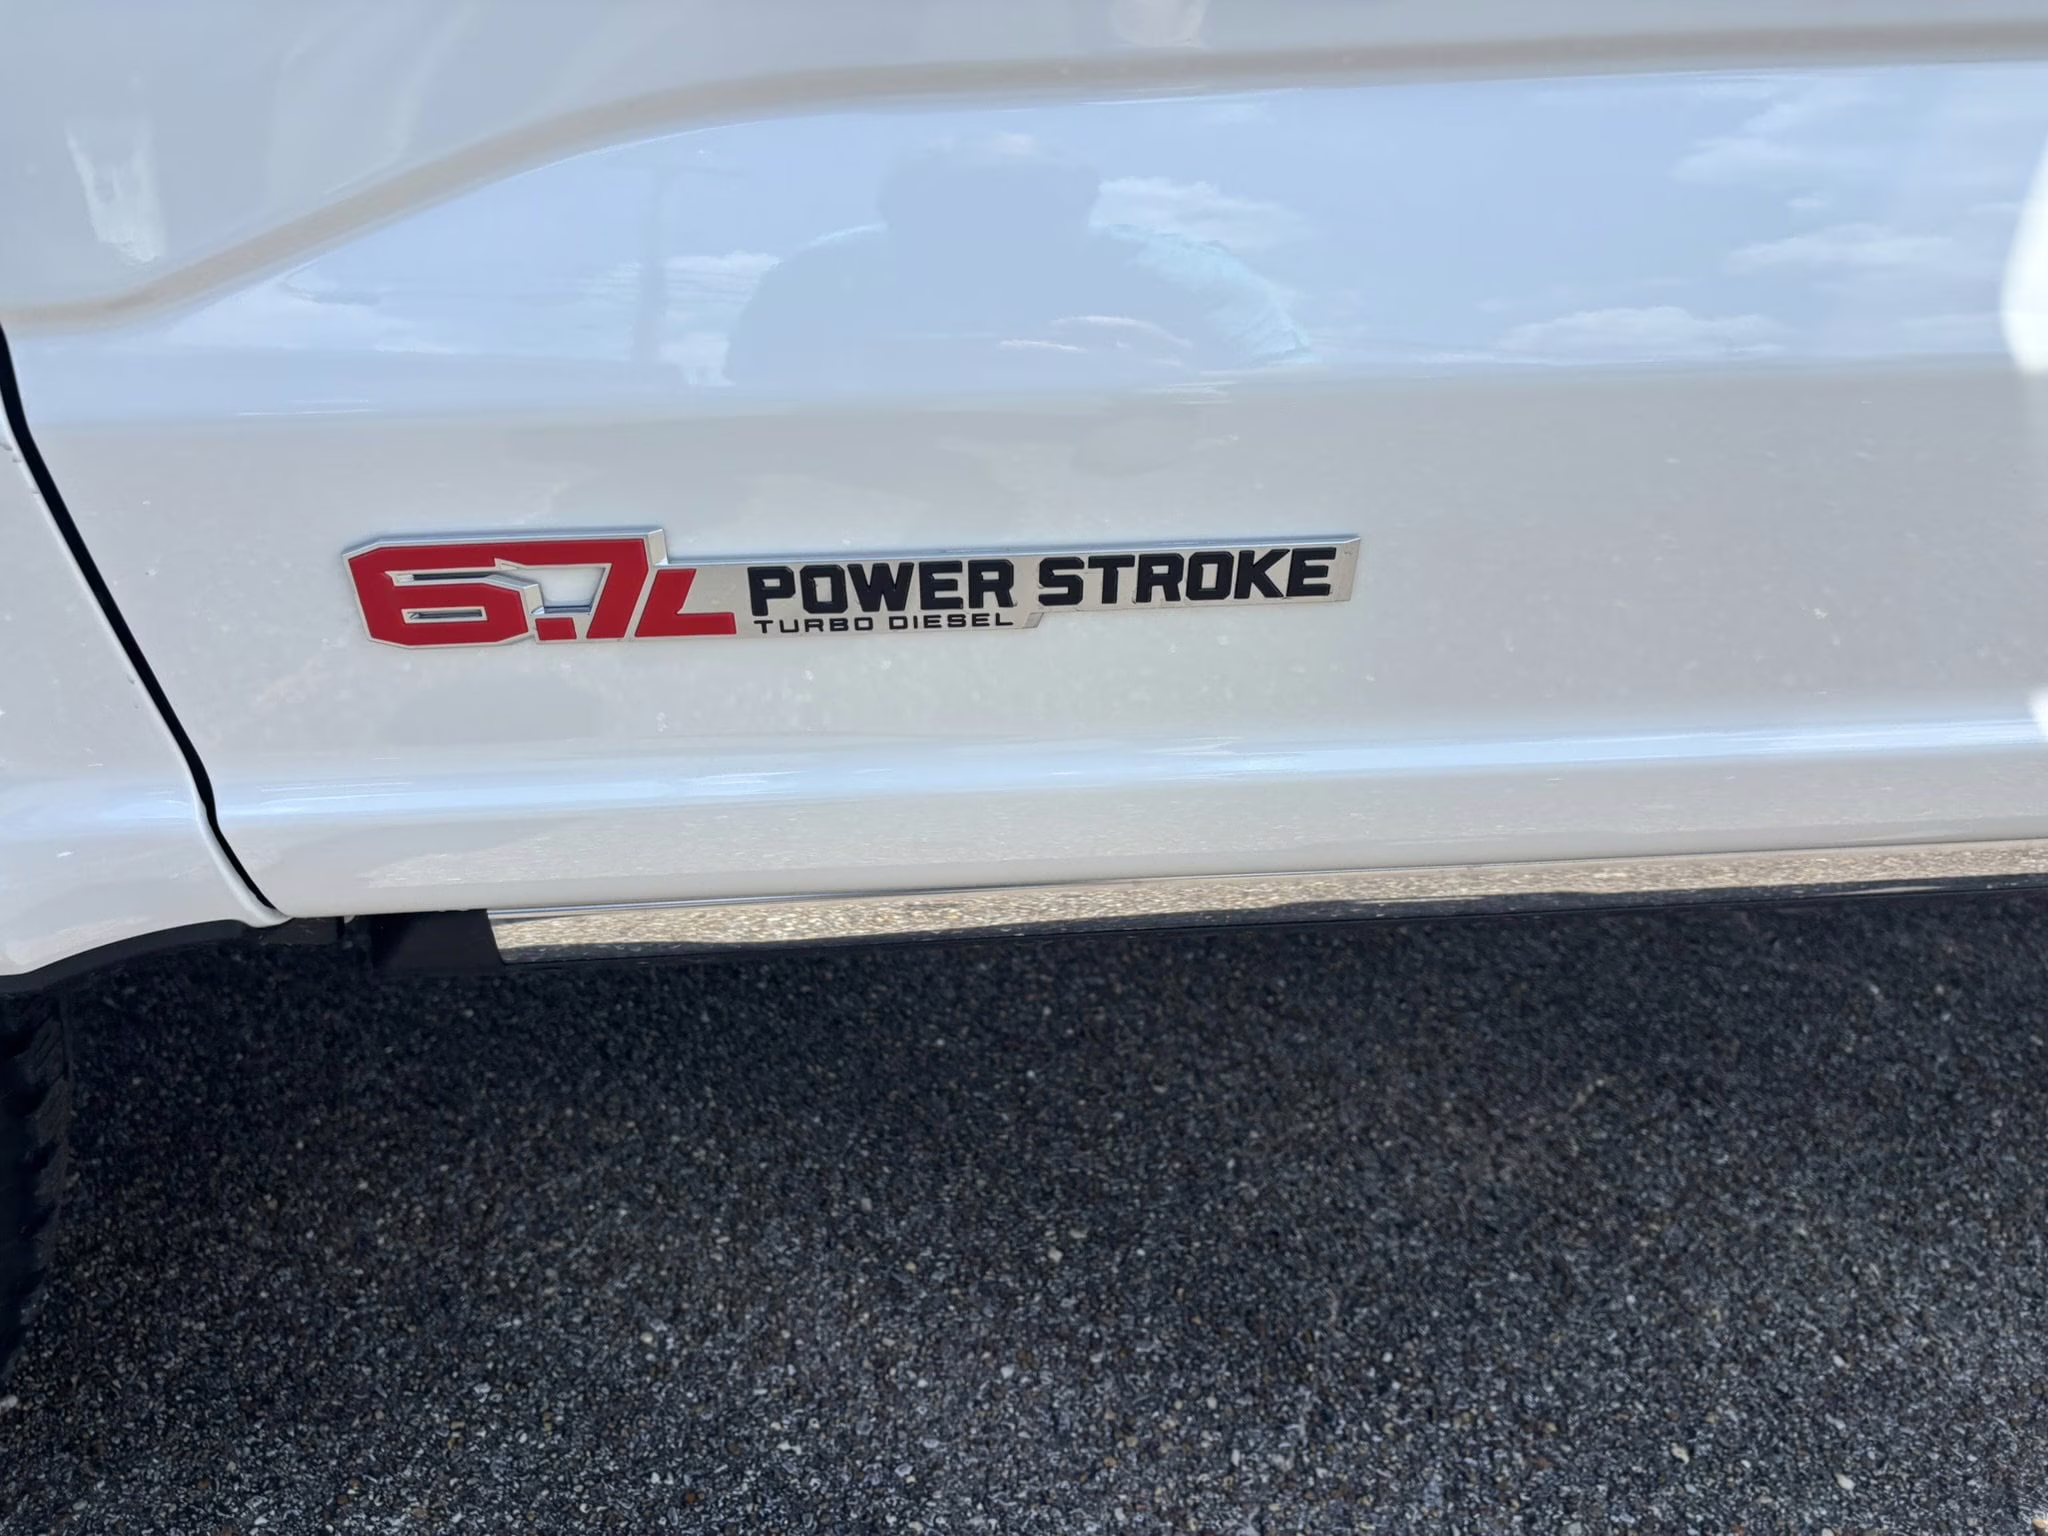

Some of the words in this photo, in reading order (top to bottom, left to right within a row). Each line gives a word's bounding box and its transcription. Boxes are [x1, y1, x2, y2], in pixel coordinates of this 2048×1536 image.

[348, 538, 737, 646] 6.7L
[747, 558, 1014, 616] POWER
[1038, 547, 1337, 606] STROKE
[753, 616, 874, 633] TURBO
[889, 613, 1013, 630] DIESEL
